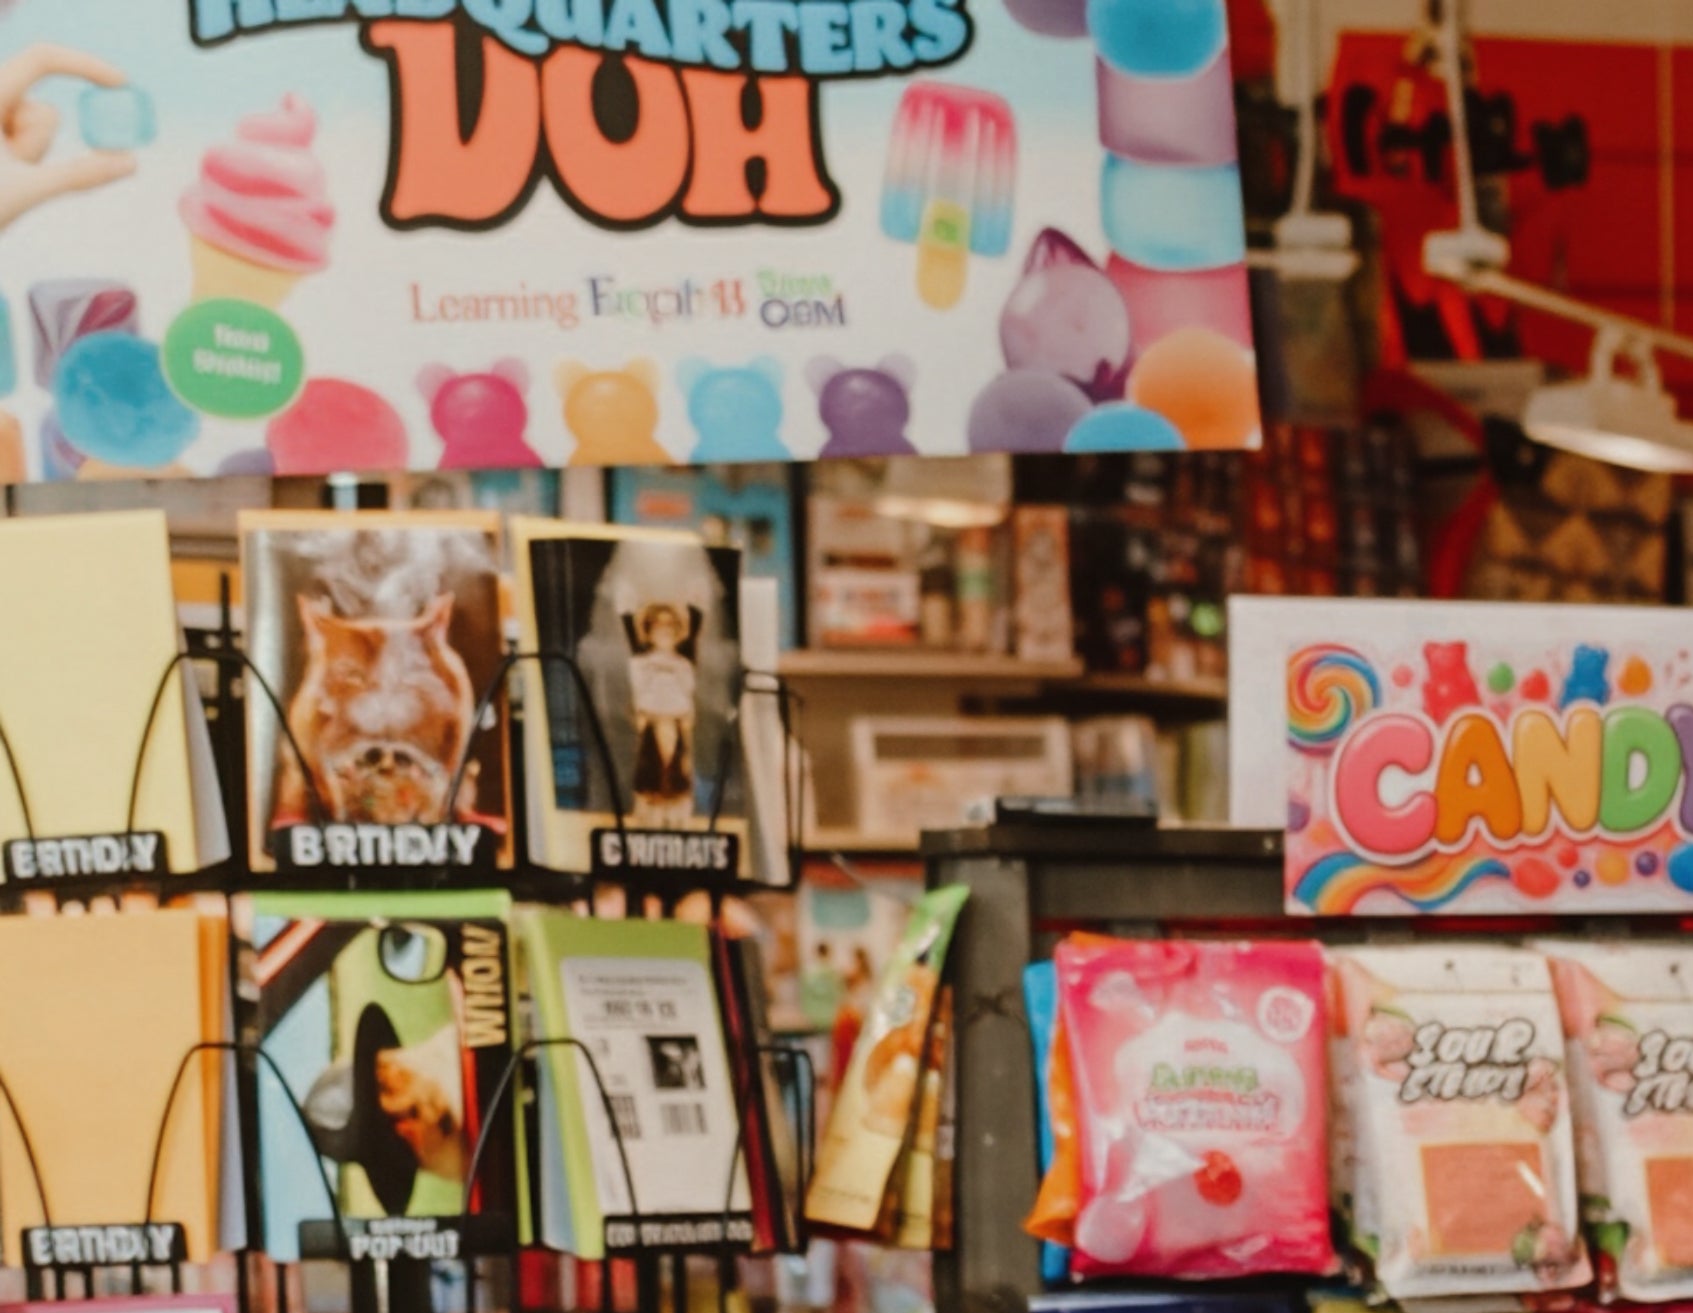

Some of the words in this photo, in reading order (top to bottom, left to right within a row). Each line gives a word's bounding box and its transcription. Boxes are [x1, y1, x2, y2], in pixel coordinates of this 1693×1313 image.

[188, 0, 970, 76] QUARTERS
[12, 832, 157, 877] BRTHDY
[290, 824, 482, 868] BRTHDY
